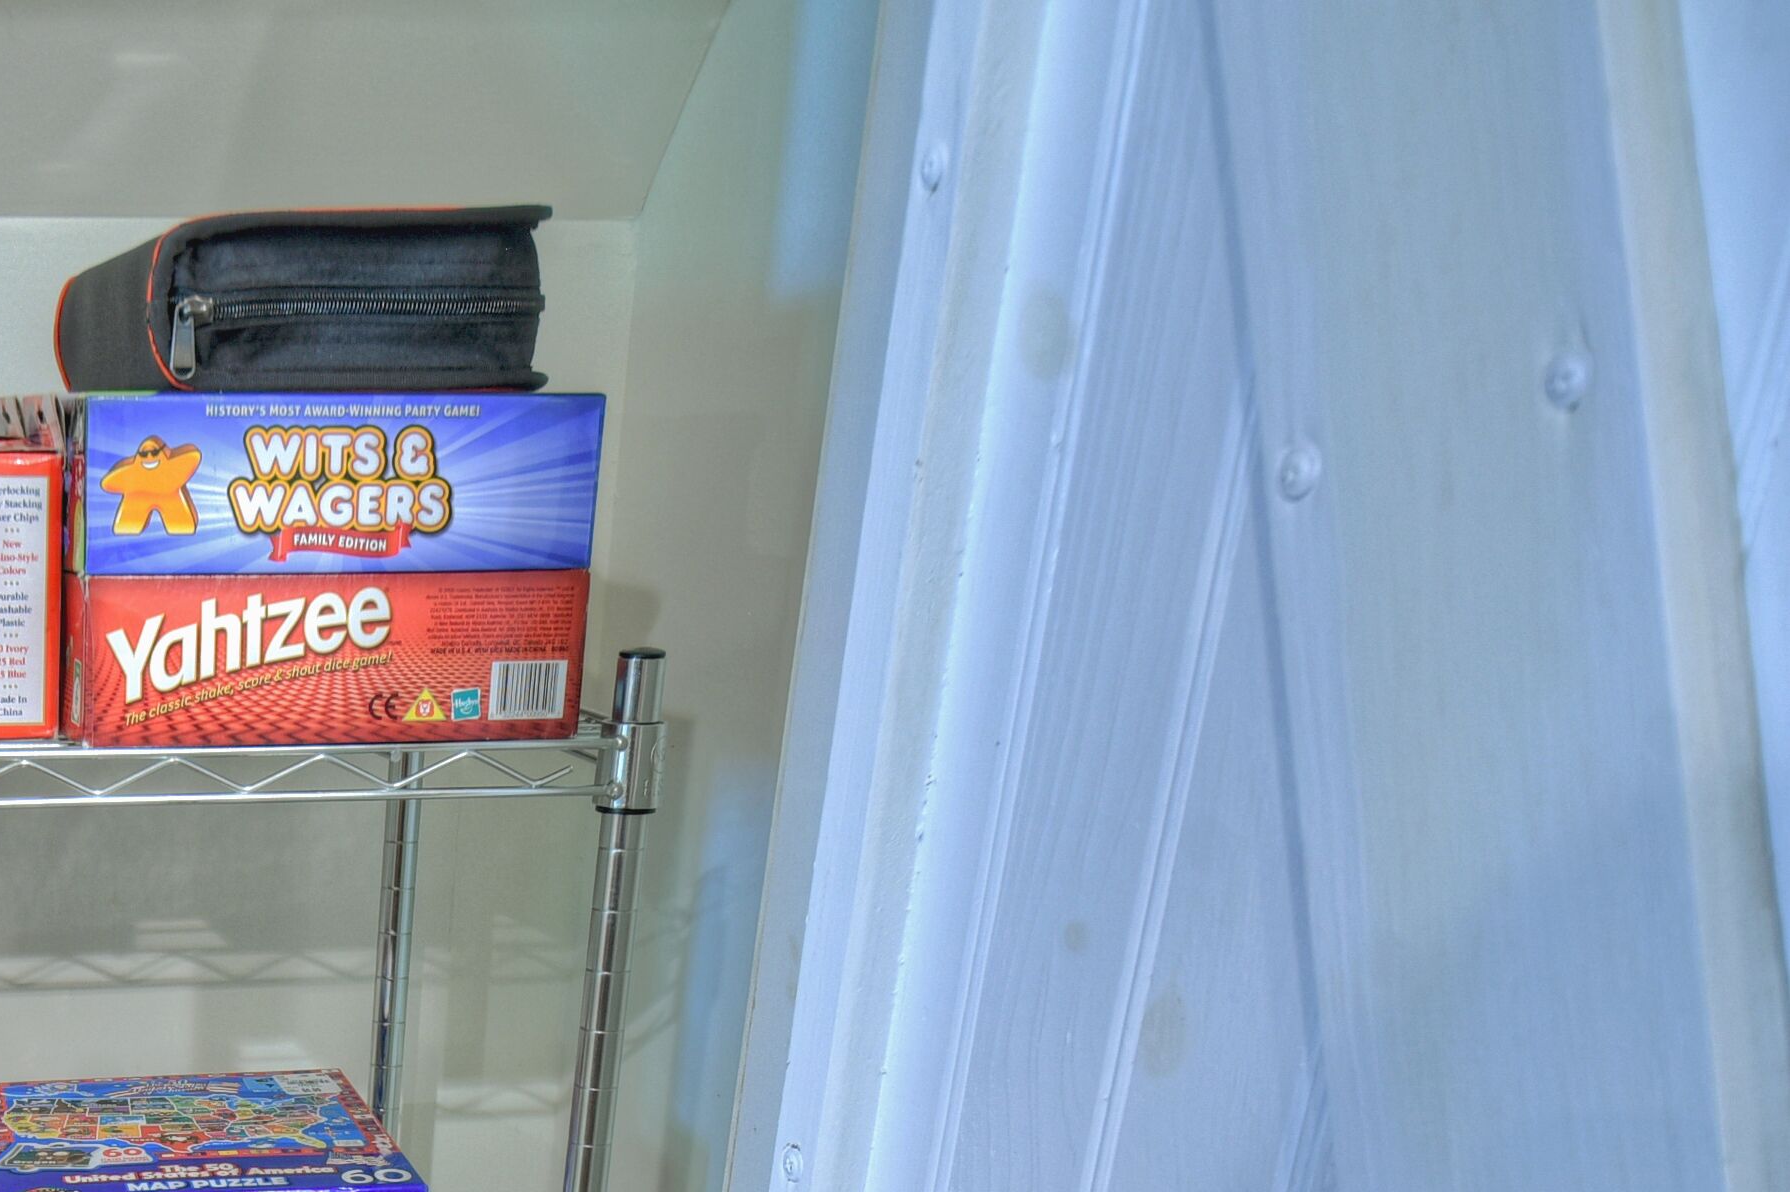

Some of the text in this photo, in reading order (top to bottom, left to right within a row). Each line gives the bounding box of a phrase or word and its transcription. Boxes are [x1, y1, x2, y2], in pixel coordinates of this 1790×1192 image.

[206, 404, 482, 418] HISTORY'S MOST AWARD-WINNING PARTY GAME!
[247, 430, 431, 479] WITS &
[4, 500, 43, 511] Stacking
[233, 482, 450, 528] WAGERS
[13, 513, 39, 524] Chips
[2, 540, 22, 549] New
[293, 533, 387, 552] FAMILY EDITION
[5, 645, 28, 655] Ivory
[106, 586, 392, 705] Yahtzee
[8, 657, 26, 666] Red
[7, 670, 27, 679] Blue
[124, 651, 394, 727] The classic shake, score & shout dice game!
[18, 696, 27, 704] In
[65, 1165, 335, 1184] United States of America
[160, 1162, 234, 1173] The 50
[341, 1168, 412, 1184] 60
[127, 1176, 290, 1192] MAP PUZZLE
